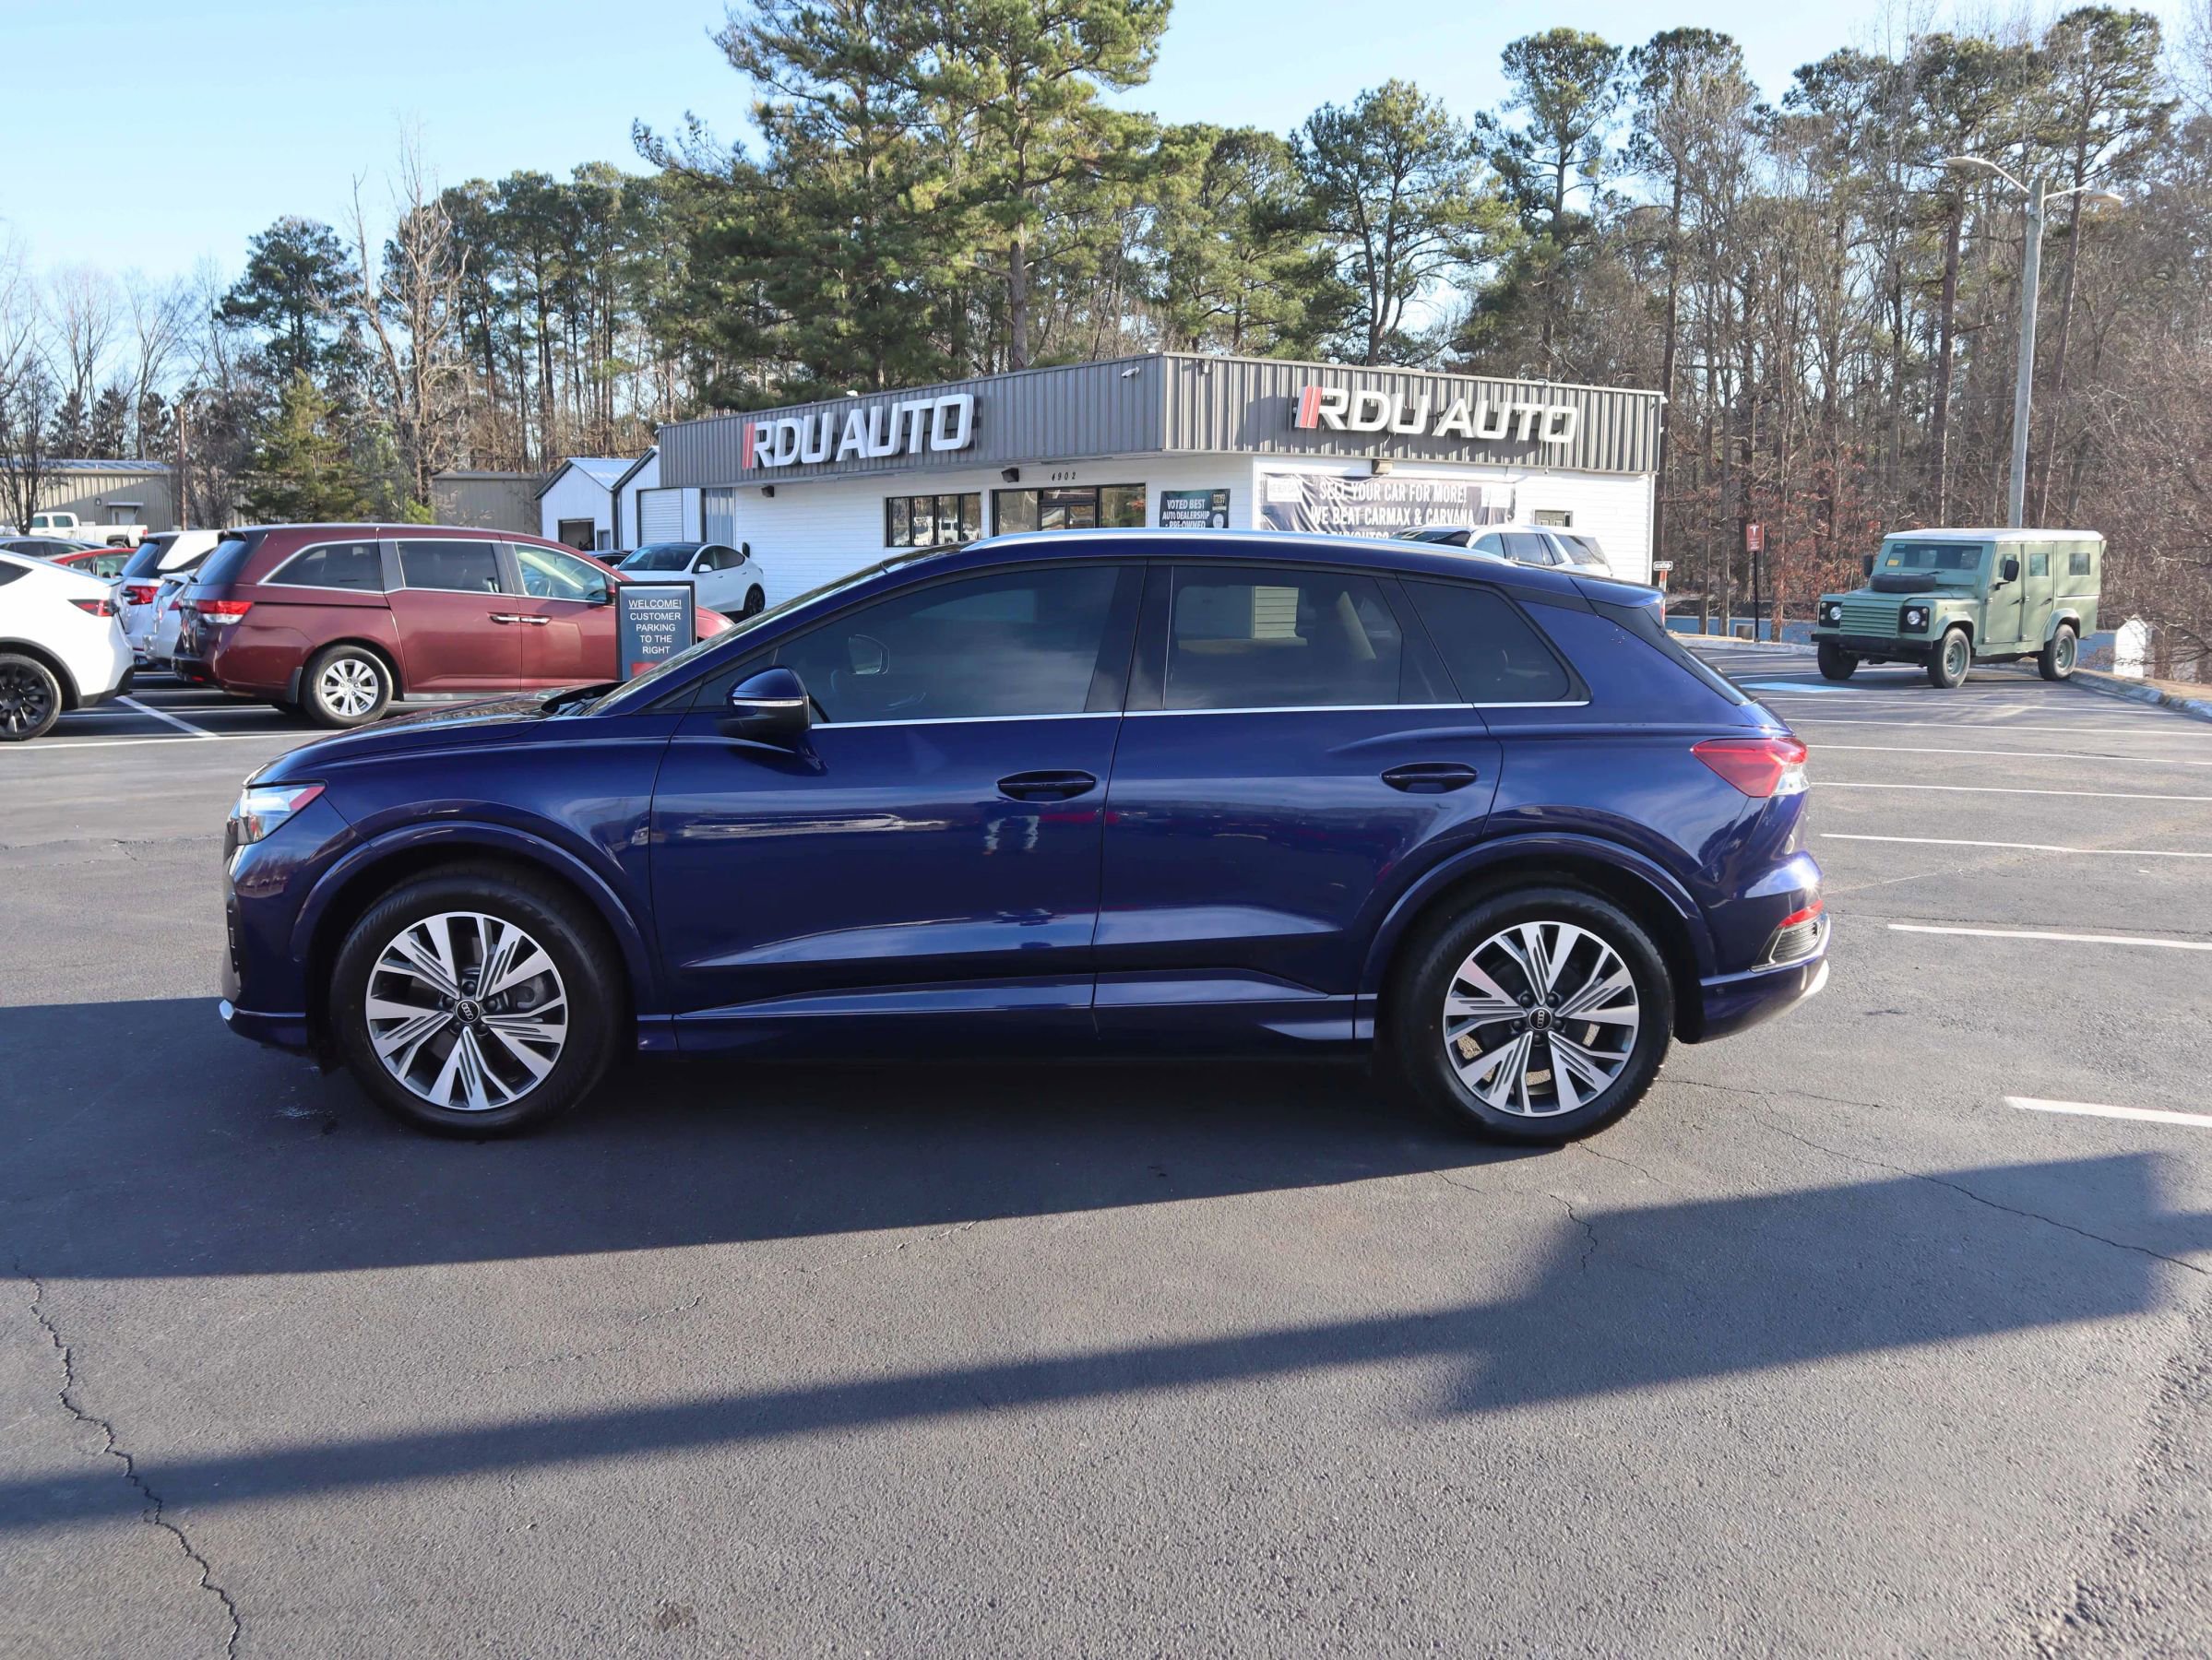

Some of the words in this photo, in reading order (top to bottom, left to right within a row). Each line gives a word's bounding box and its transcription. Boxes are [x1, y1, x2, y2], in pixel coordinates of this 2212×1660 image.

[1308, 386, 1430, 434] RDU
[1432, 397, 1578, 444] AUTO
[751, 411, 834, 468] RDU
[836, 393, 974, 461] AUTO
[1319, 480, 1350, 500] SELL
[1350, 481, 1381, 501] YOUR
[1384, 483, 1406, 501] CAR
[1409, 484, 1431, 503] FOR
[1433, 485, 1468, 504] MORE!
[1167, 499, 1188, 509] VOTED
[1189, 498, 1206, 509] BEST
[1162, 511, 1176, 520] AUTO
[1176, 511, 1210, 520] DEALERSHIP
[1310, 505, 1329, 525] WE
[1332, 506, 1362, 525] BEAT
[1364, 507, 1410, 526] CARMAX
[1414, 509, 1422, 526] &
[1426, 508, 1475, 526] CARVANA
[628, 599, 682, 610] WELCOME!
[629, 612, 681, 621] CUSTOMER
[636, 623, 676, 632] PARKING
[639, 634, 652, 643] TO
[654, 634, 672, 643] THE
[642, 646, 671, 655] RIGHT
